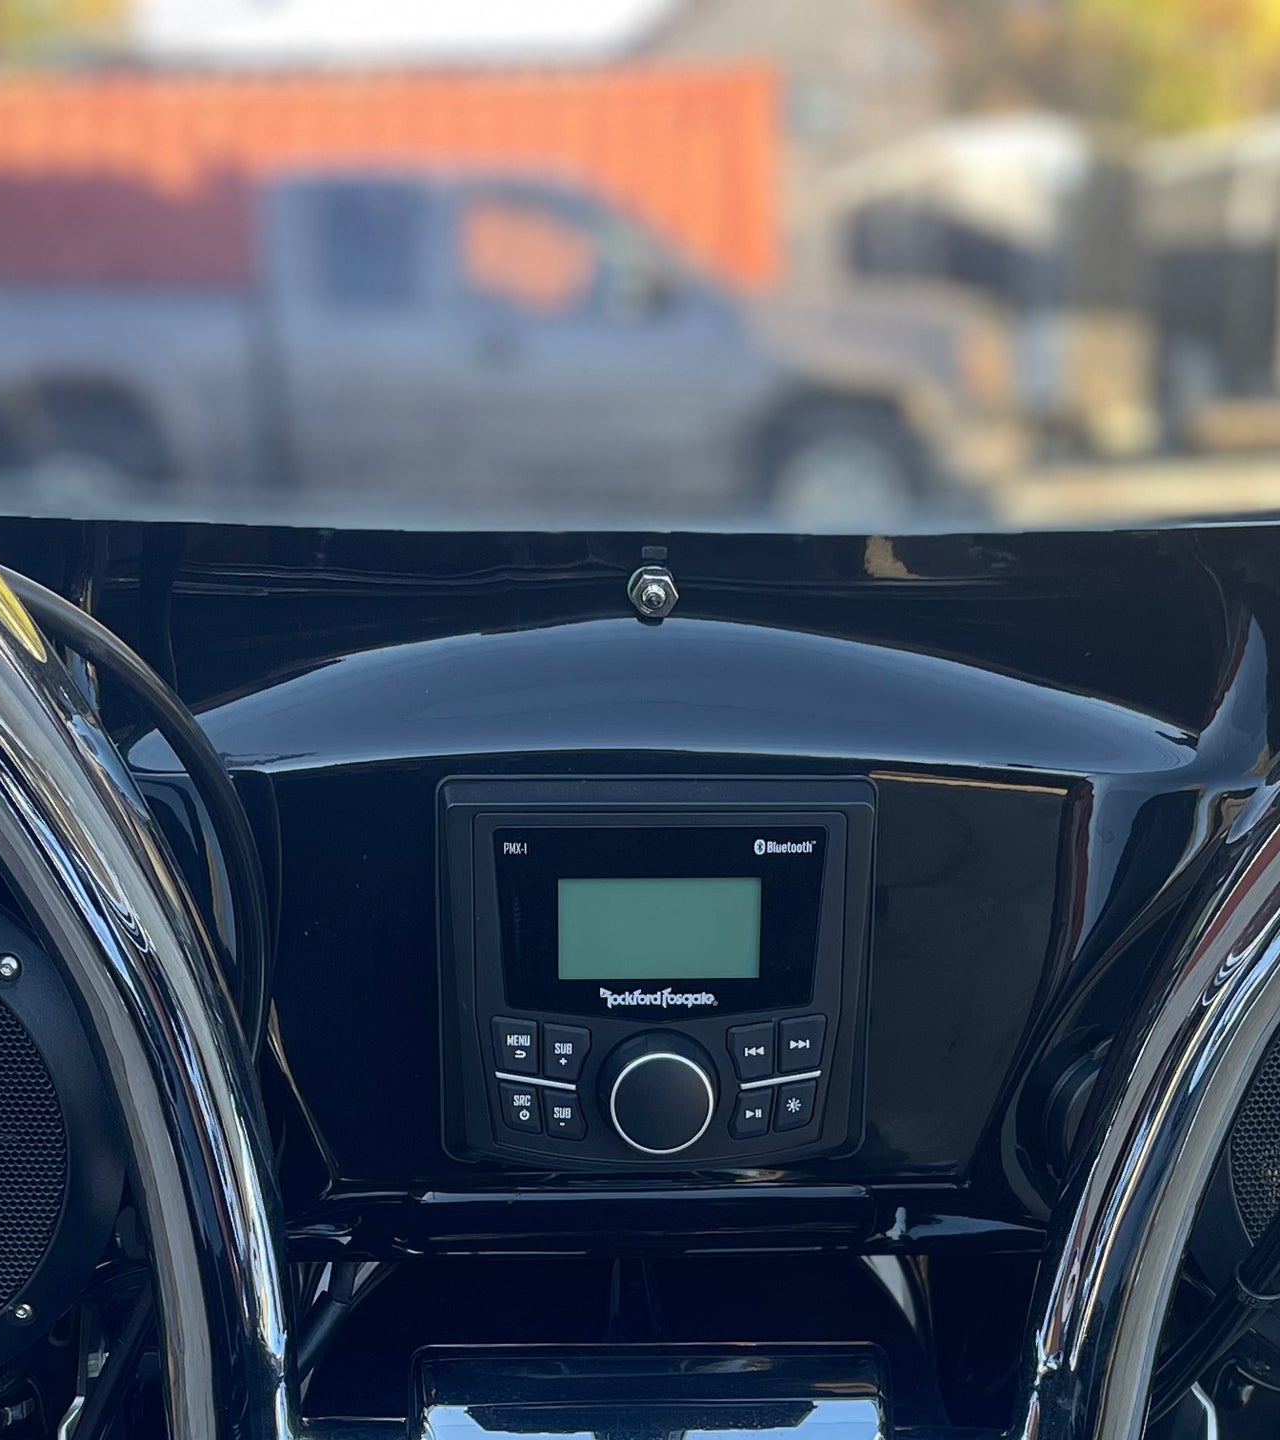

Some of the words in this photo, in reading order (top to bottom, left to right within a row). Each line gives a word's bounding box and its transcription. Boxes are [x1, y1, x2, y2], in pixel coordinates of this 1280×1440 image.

[766, 840, 813, 854] Bluetooth
[506, 1034, 531, 1047] MENU
[554, 1042, 573, 1055] SUB
[513, 1094, 532, 1107] SRC
[553, 1106, 572, 1119] SUB
